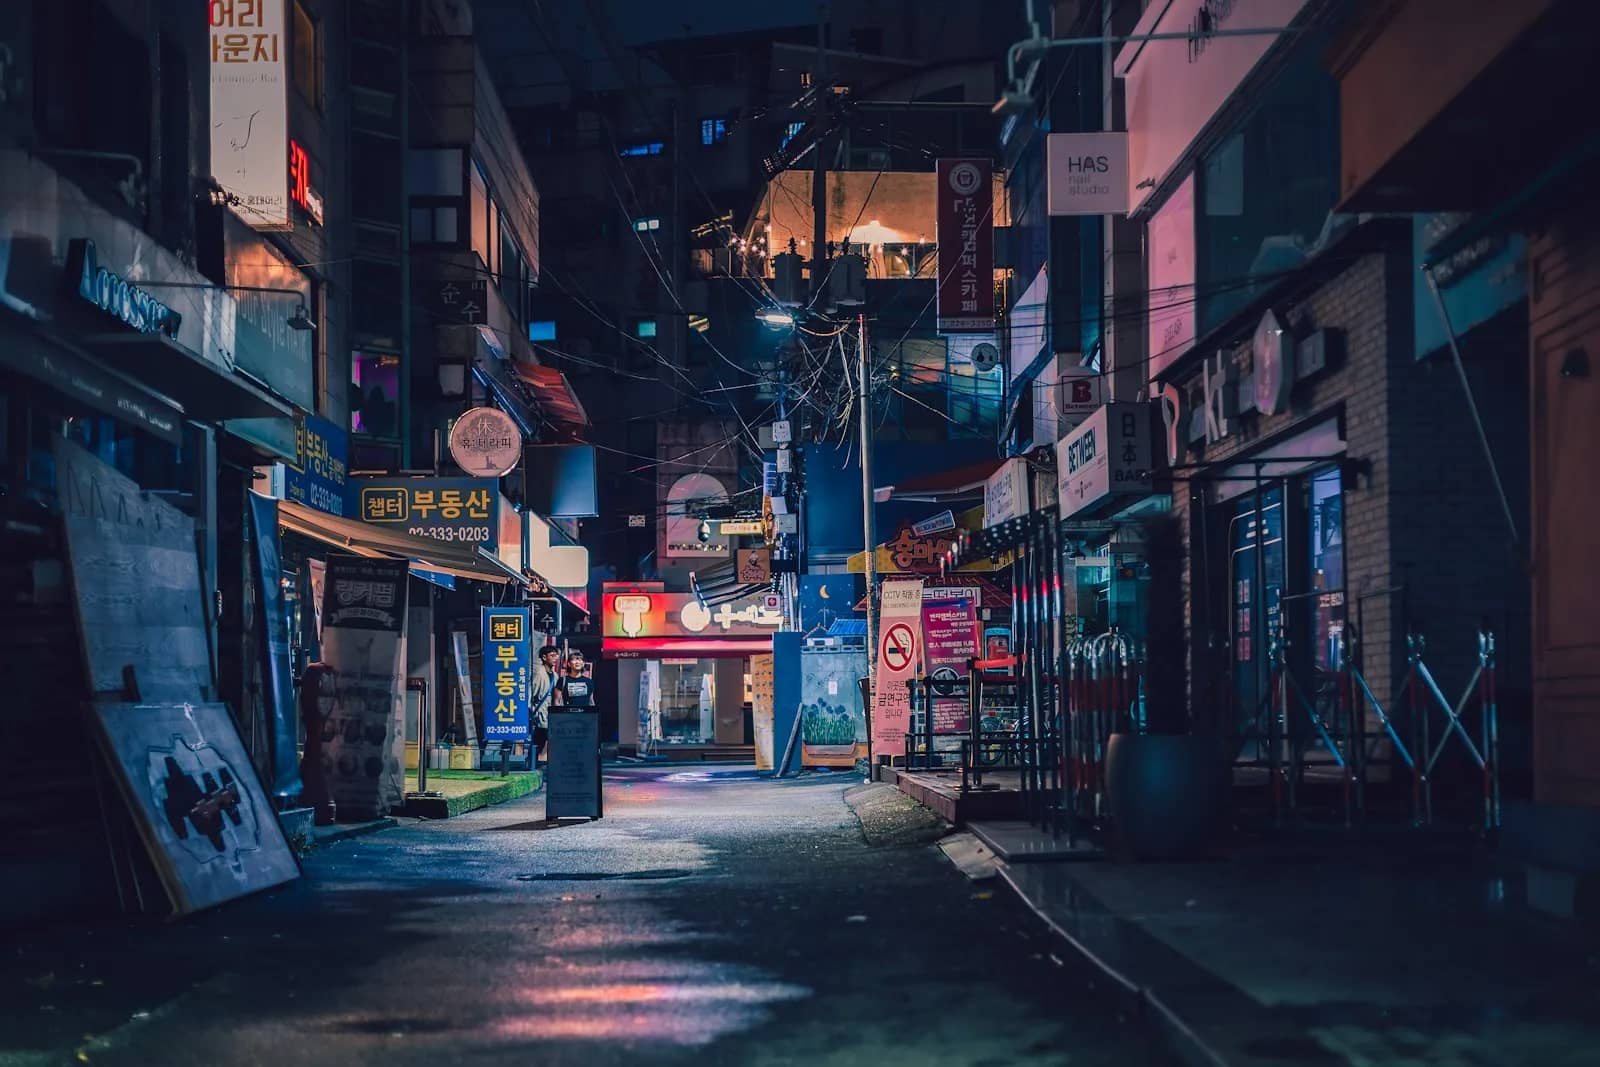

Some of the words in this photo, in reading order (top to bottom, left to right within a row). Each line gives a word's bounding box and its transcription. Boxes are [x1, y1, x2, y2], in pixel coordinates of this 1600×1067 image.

[1068, 156, 1109, 173] HAS
[1068, 427, 1096, 475] BETWEEN
[367, 491, 403, 518] 챕터
[411, 489, 491, 519] 부동산
[494, 619, 519, 638] 챕터
[494, 645, 518, 722] 부동산
[486, 725, 527, 734] 02-333-0203
